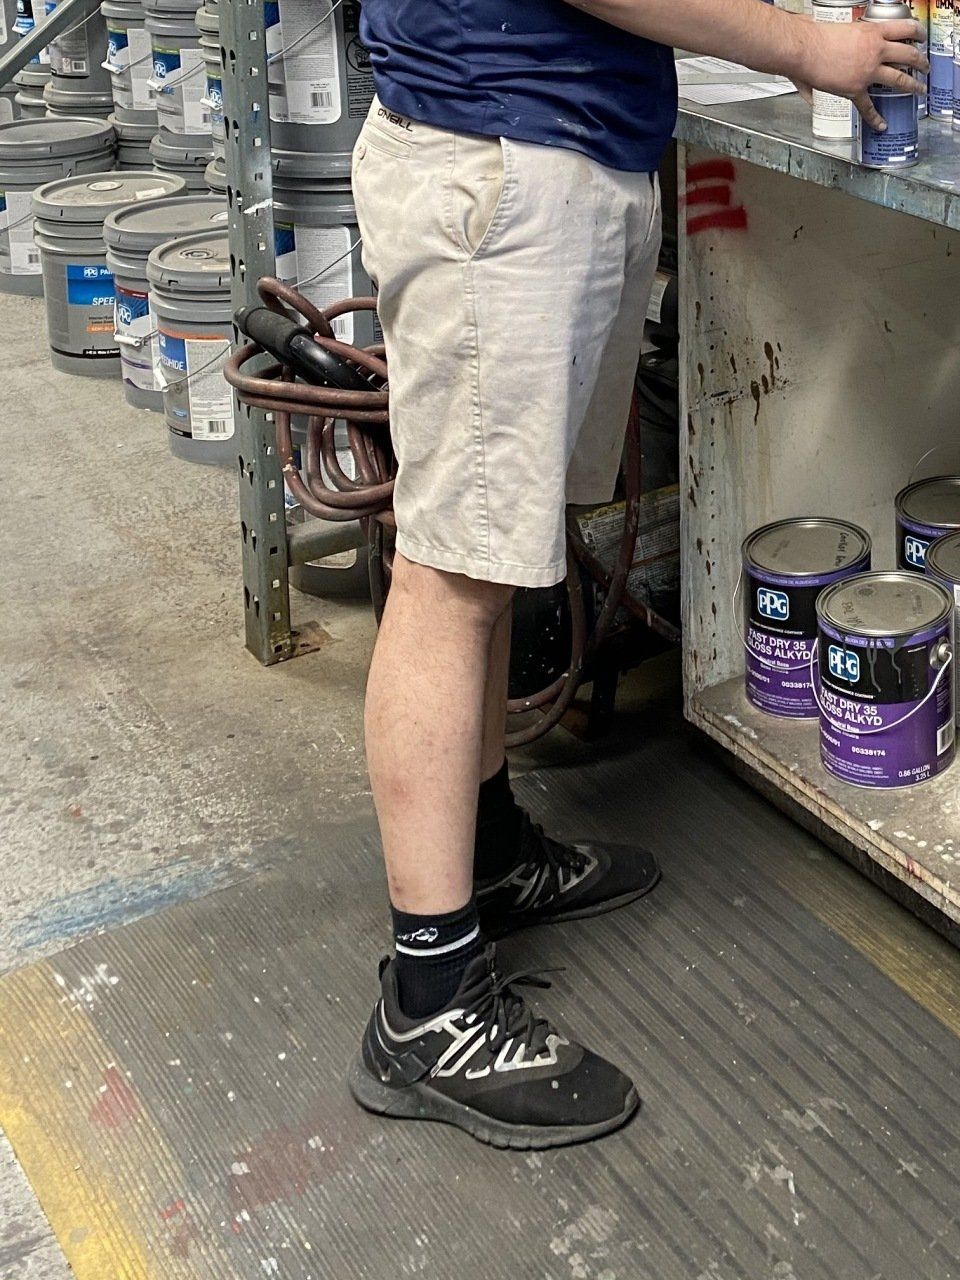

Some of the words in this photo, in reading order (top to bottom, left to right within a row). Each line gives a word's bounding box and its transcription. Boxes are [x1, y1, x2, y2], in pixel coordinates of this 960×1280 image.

[759, 593, 787, 614] PPG
[749, 628, 767, 644] FAST
[769, 638, 791, 650] DRY
[793, 640, 806, 650] 35
[774, 647, 811, 660] ALKYD
[822, 688, 838, 704] FAST
[839, 696, 861, 712] DRY
[864, 705, 877, 716] 35
[844, 710, 882, 726] ALKYD
[852, 746, 886, 757] 00338174
[912, 764, 930, 774] GALLON
